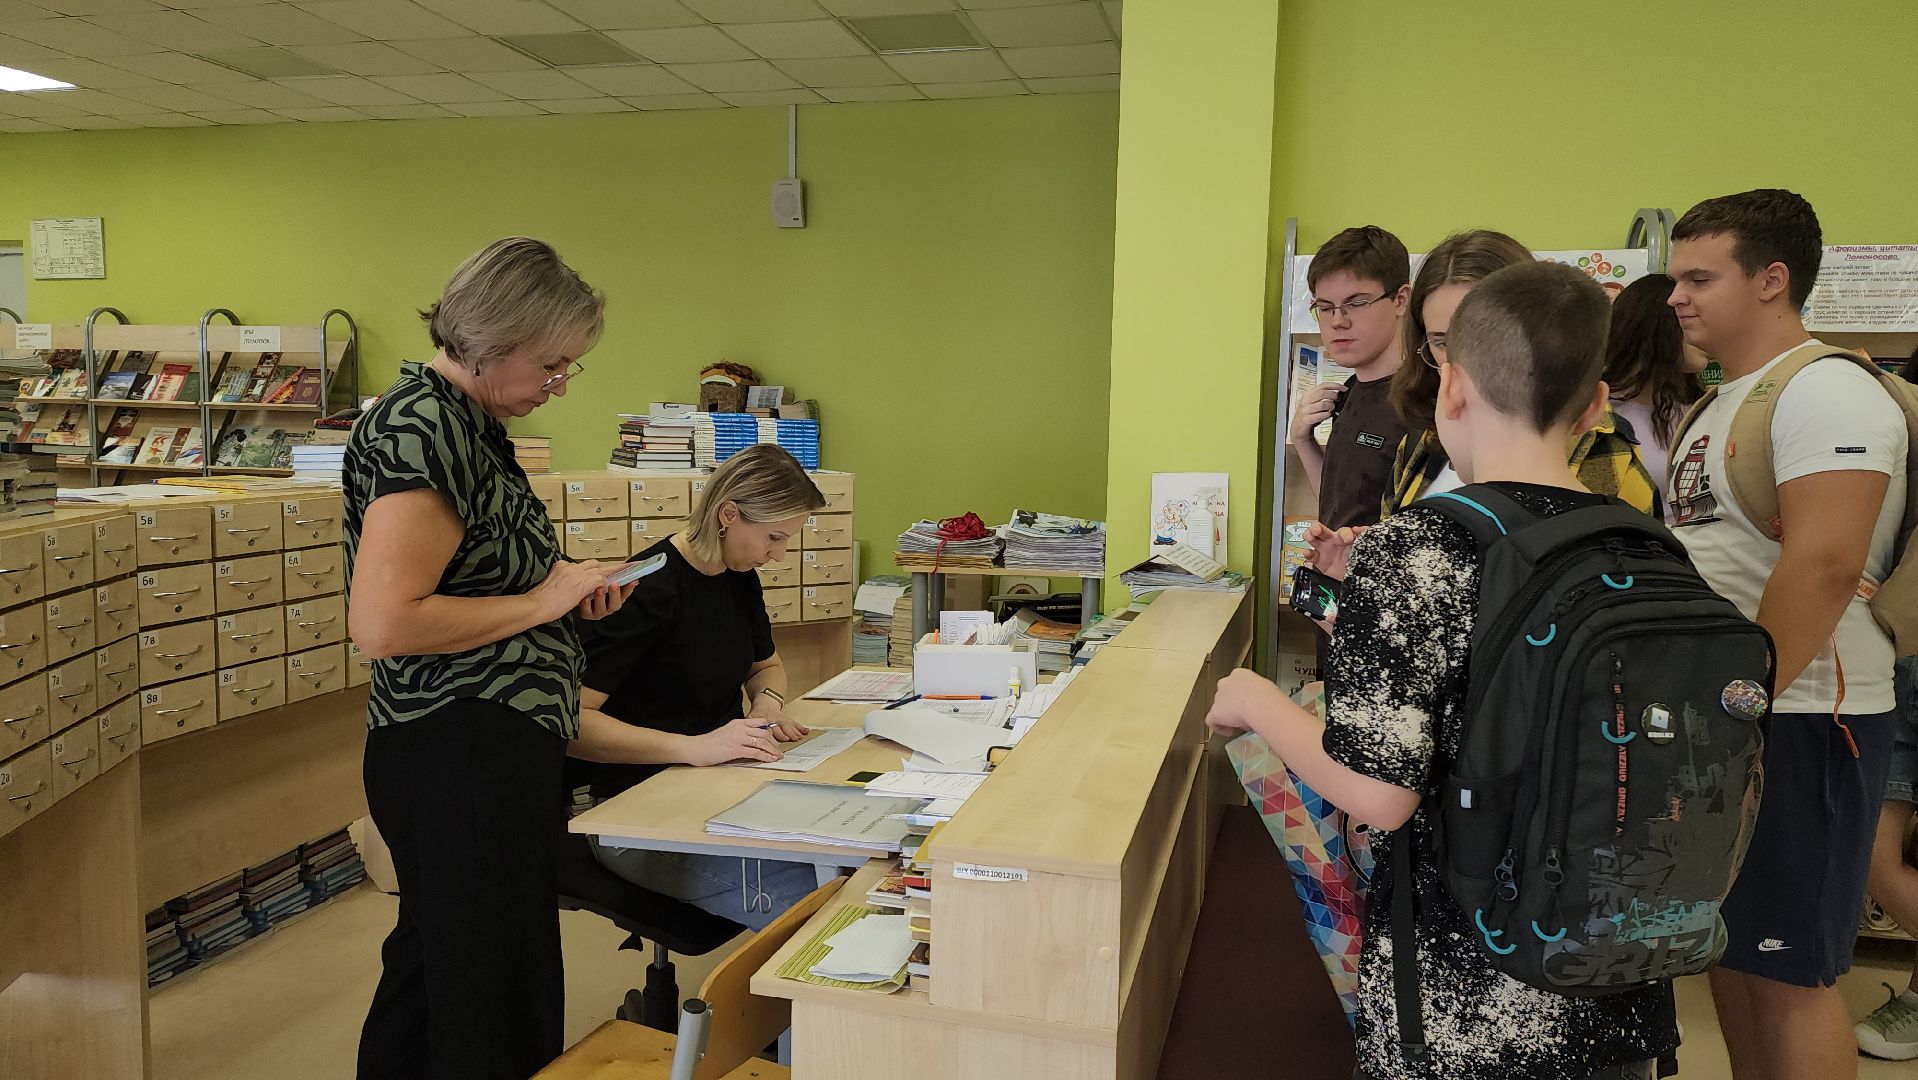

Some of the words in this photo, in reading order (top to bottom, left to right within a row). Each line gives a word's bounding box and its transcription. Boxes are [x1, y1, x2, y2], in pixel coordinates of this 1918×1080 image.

[220, 509, 230, 519] 5г
[140, 515, 153, 526] 5в
[47, 535, 56, 547] 5а
[220, 564, 231, 574] 6г
[146, 693, 158, 704] 8в
[1762, 938, 1785, 948] NIKE
